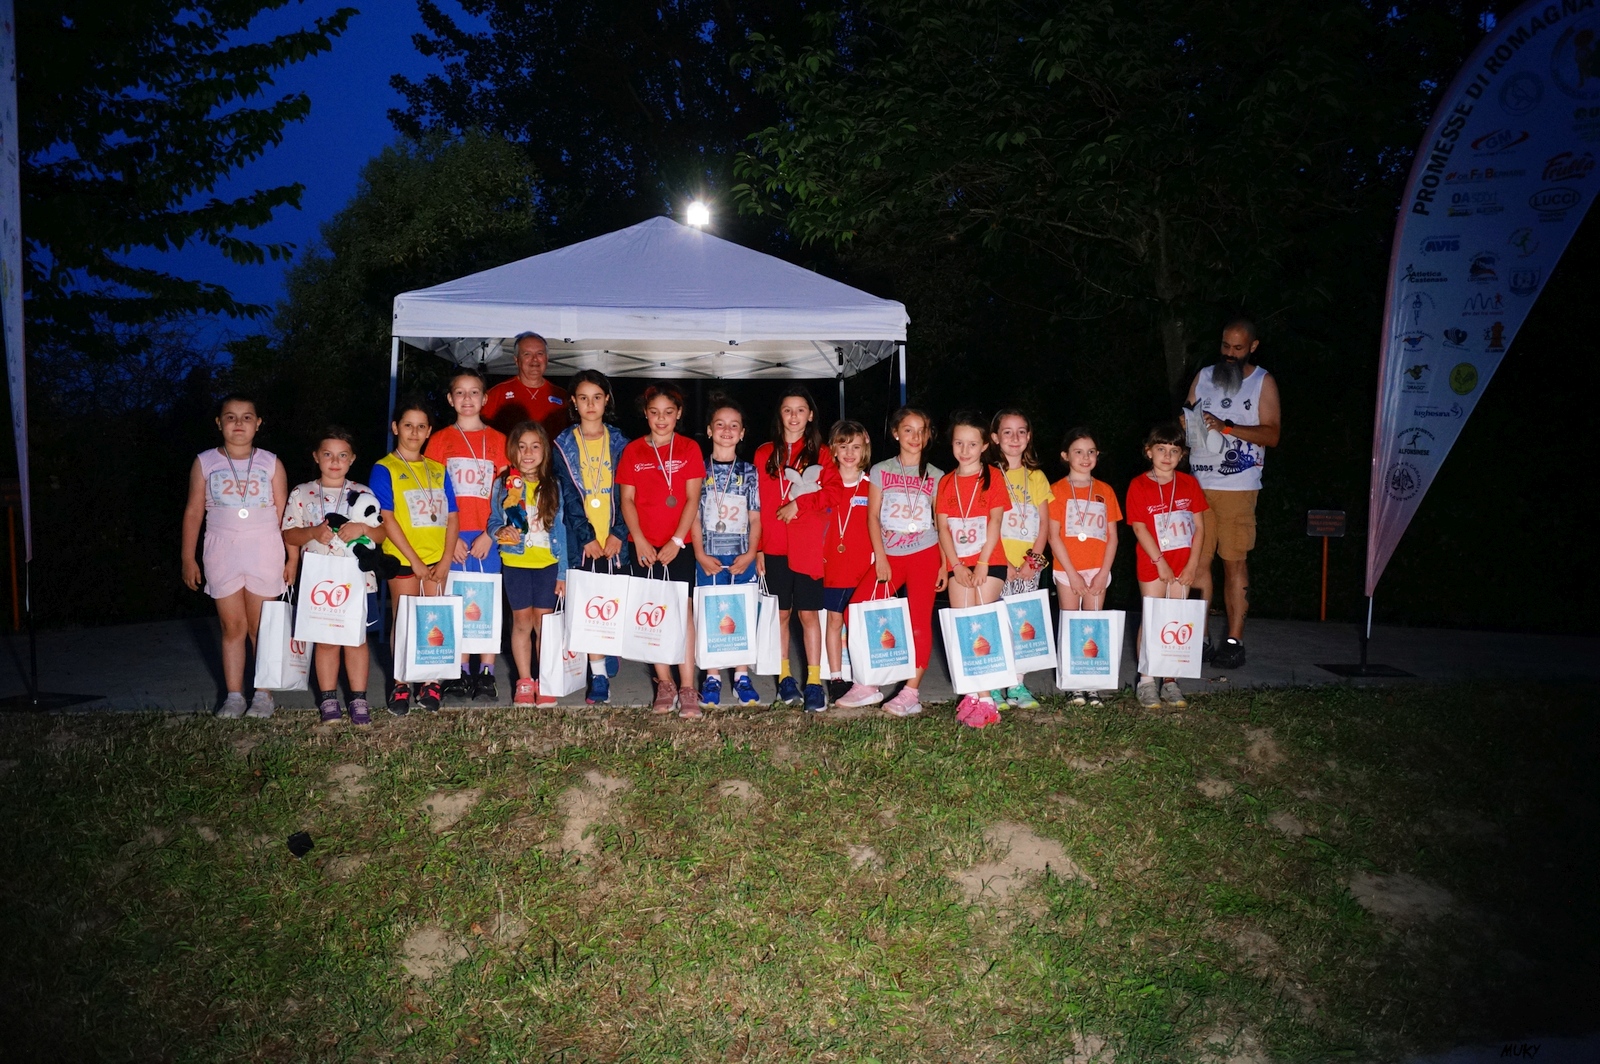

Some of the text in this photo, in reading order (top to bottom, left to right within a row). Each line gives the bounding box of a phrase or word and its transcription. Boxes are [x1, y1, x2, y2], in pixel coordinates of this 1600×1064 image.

[1412, 101, 1474, 216] PROMESSE
[1465, 73, 1491, 100] DI
[1483, 0, 1595, 75] ROMAGNA
[1485, 129, 1512, 149] GM
[1534, 193, 1576, 207] LUCCI
[1425, 240, 1460, 252] AVIS
[1414, 410, 1450, 418] lughesina
[455, 468, 485, 486] 102
[222, 480, 260, 496] 253
[718, 504, 740, 522] 92
[890, 504, 924, 520] 252
[1074, 512, 1105, 529] 270
[1168, 521, 1193, 538] 111
[310, 580, 351, 608] 60
[585, 596, 619, 620] 60
[636, 602, 666, 628] 60
[1160, 620, 1192, 646] 60
